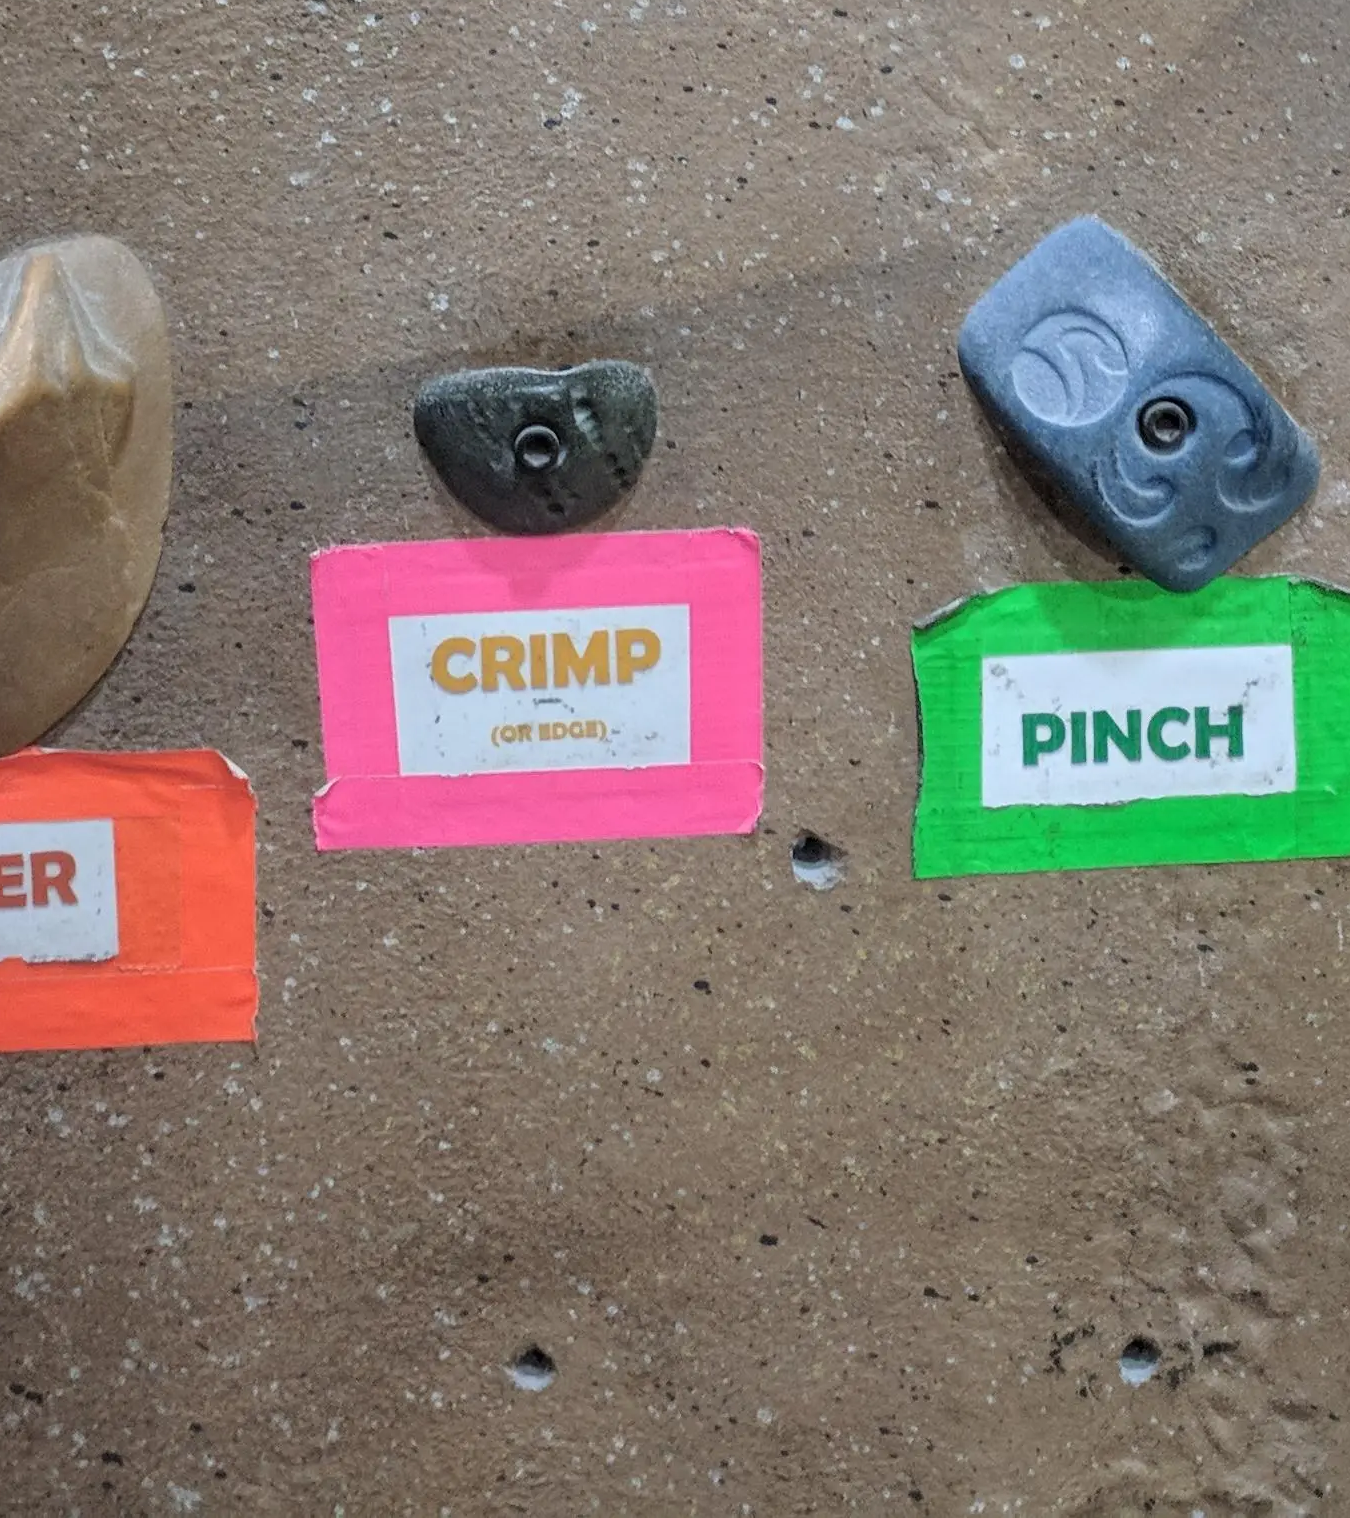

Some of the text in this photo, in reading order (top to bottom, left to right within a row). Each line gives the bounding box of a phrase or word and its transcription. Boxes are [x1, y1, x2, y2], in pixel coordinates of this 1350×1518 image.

[431, 627, 662, 695] CRIMP
[490, 720, 608, 747] (OR EDGE)
[1021, 704, 1244, 767] PINCH
